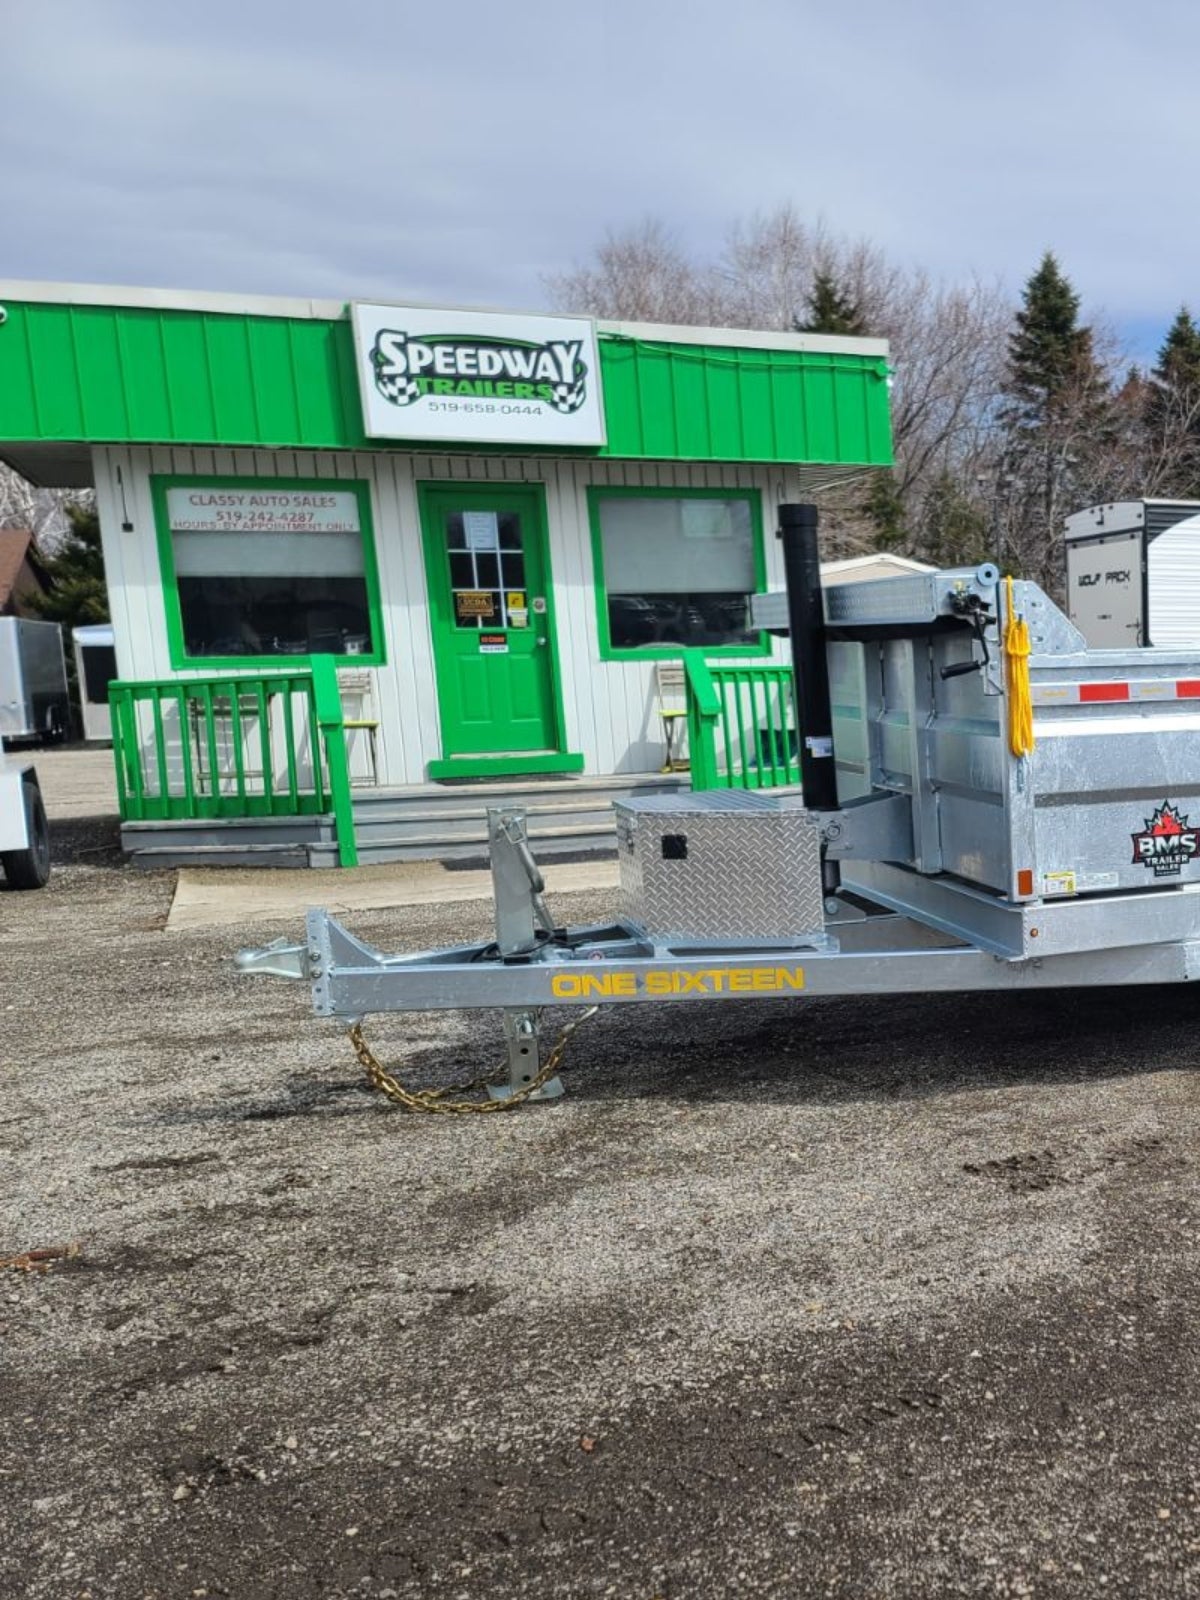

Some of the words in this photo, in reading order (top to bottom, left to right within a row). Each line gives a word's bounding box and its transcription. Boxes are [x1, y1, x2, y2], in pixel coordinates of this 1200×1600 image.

[376, 330, 581, 384] SPEEDWAY
[415, 377, 554, 401] TRAILERS
[428, 401, 543, 415] 519-658-0444
[189, 494, 245, 506] CLASSY
[250, 495, 290, 507] AUTO
[292, 496, 337, 508] SALES
[215, 511, 315, 522] 519-242-4287
[223, 521, 237, 529] BY
[242, 521, 322, 530] APPOINTMENT
[1105, 571, 1130, 584] PACK
[1138, 833, 1197, 856] BMS
[1145, 854, 1189, 866] TRAILER
[551, 973, 636, 997] ONE
[645, 967, 805, 994] SIXTEEN
